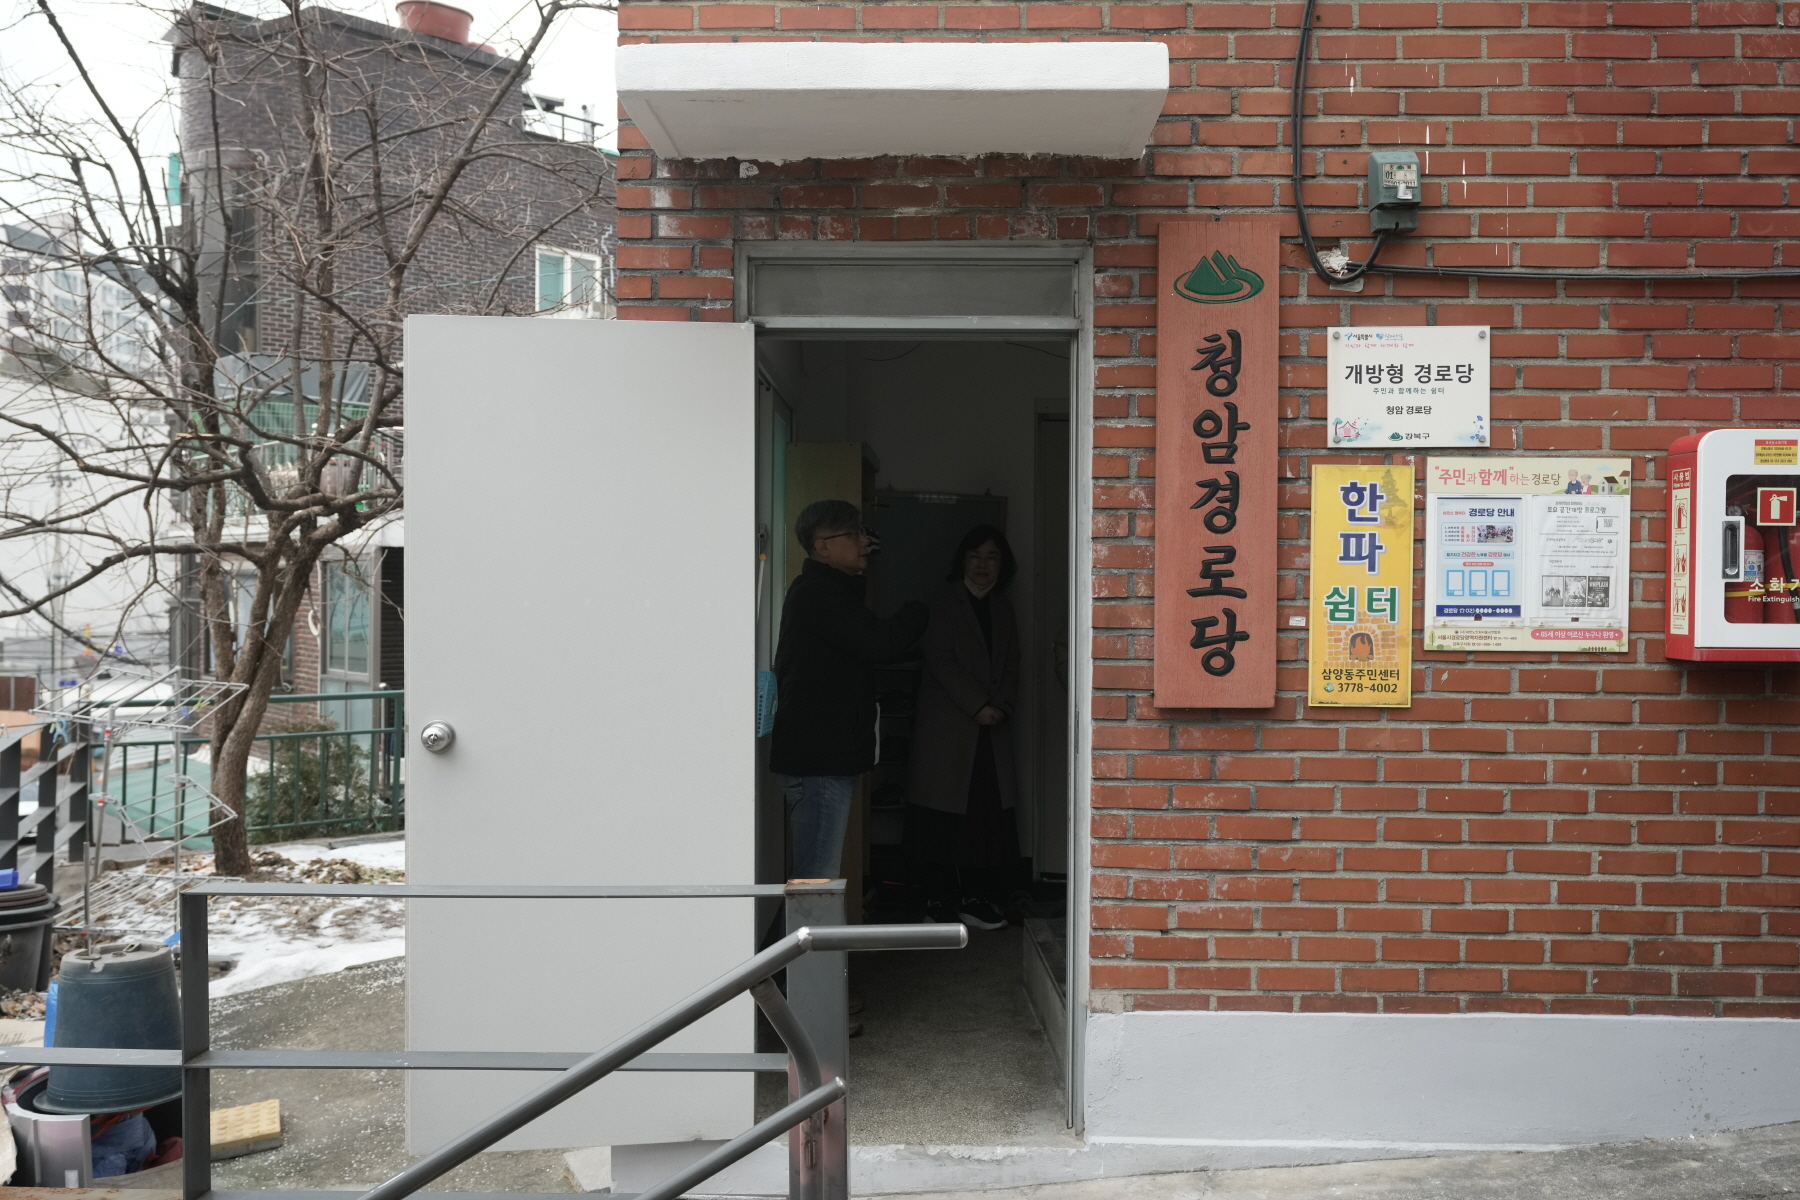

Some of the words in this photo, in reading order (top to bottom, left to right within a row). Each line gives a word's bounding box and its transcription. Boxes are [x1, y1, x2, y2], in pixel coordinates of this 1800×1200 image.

[1344, 363, 1404, 385] 개방형
[1414, 363, 1475, 385] 경로당
[1373, 387, 1395, 395] 주민과
[1398, 387, 1427, 395] 함께하는
[1431, 387, 1445, 395] 쉼터
[1385, 405, 1404, 415] 청암
[1405, 405, 1432, 415] 경로당
[1405, 432, 1430, 440] 강북구
[1510, 473, 1530, 486] 하는
[1531, 473, 1561, 486] 경로당
[1186, 328, 1251, 677] 청암경로당
[1469, 507, 1495, 517] 경로당
[1497, 507, 1515, 517] 안내
[1337, 480, 1388, 575] 한파
[1323, 585, 1399, 624] 쉼터
[1540, 630, 1554, 638] 65세
[1554, 630, 1566, 638] 이상
[1567, 630, 1584, 638] 어르신
[1585, 630, 1602, 639] 누구나
[1602, 630, 1614, 639] 환영
[1321, 668, 1400, 681] 삼양동주민센터
[1337, 683, 1398, 693] 3778-4002
